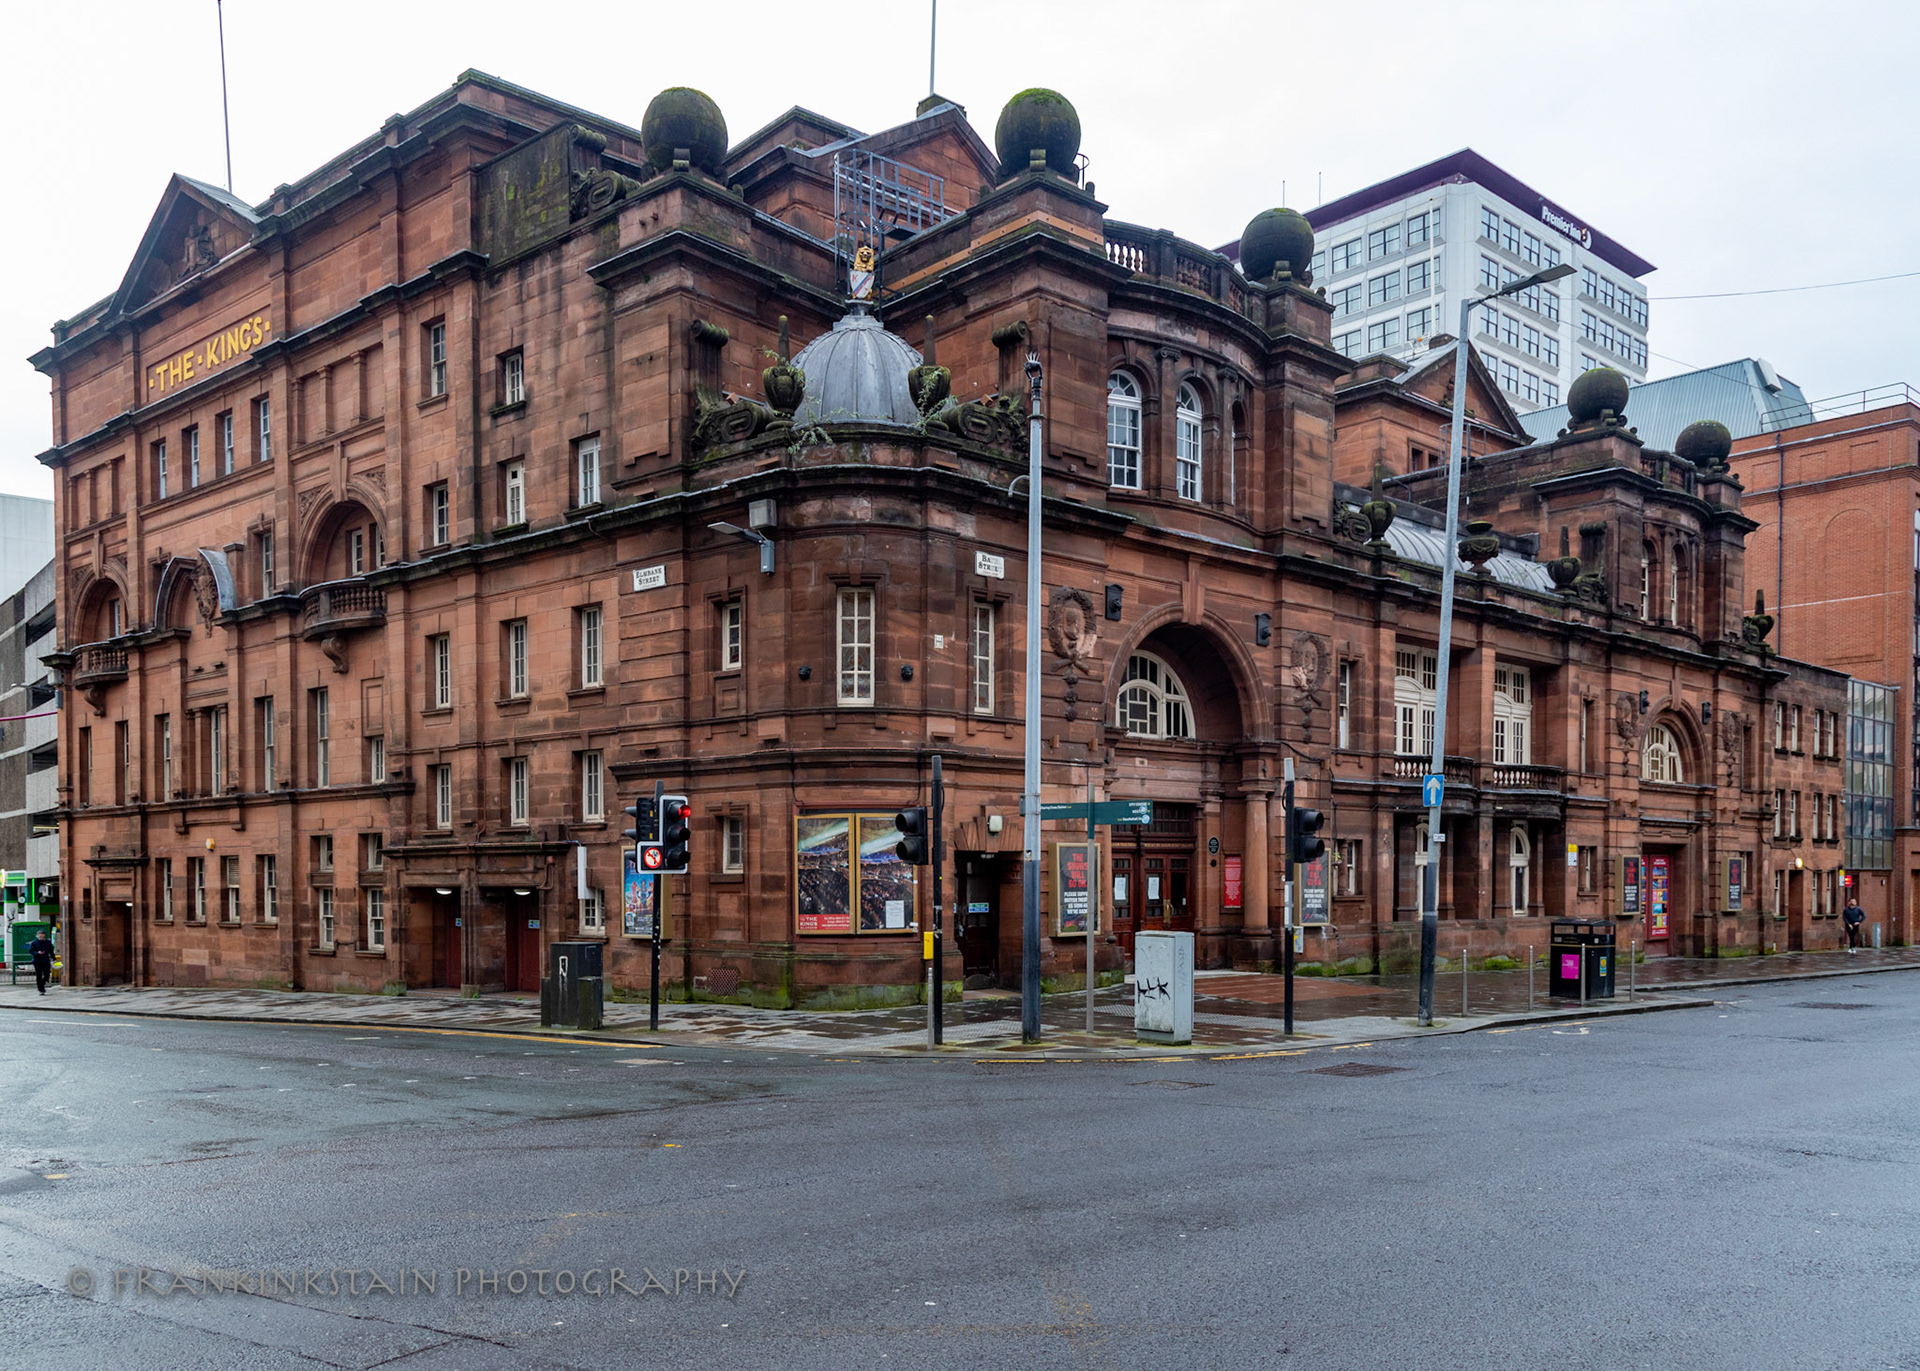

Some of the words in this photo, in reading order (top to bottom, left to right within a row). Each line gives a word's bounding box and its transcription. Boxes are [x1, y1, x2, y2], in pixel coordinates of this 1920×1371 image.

[1542, 205, 1570, 233] Premier
[1570, 222, 1582, 241] Inn
[155, 350, 195, 392] THE
[206, 316, 263, 369] KING'S
[636, 567, 662, 579] ELMBANK
[638, 575, 660, 586] STREET
[1072, 853, 1084, 862] THE
[1067, 862, 1088, 871] SHOWS
[1071, 870, 1085, 880] WILL
[1068, 879, 1077, 888] GO
